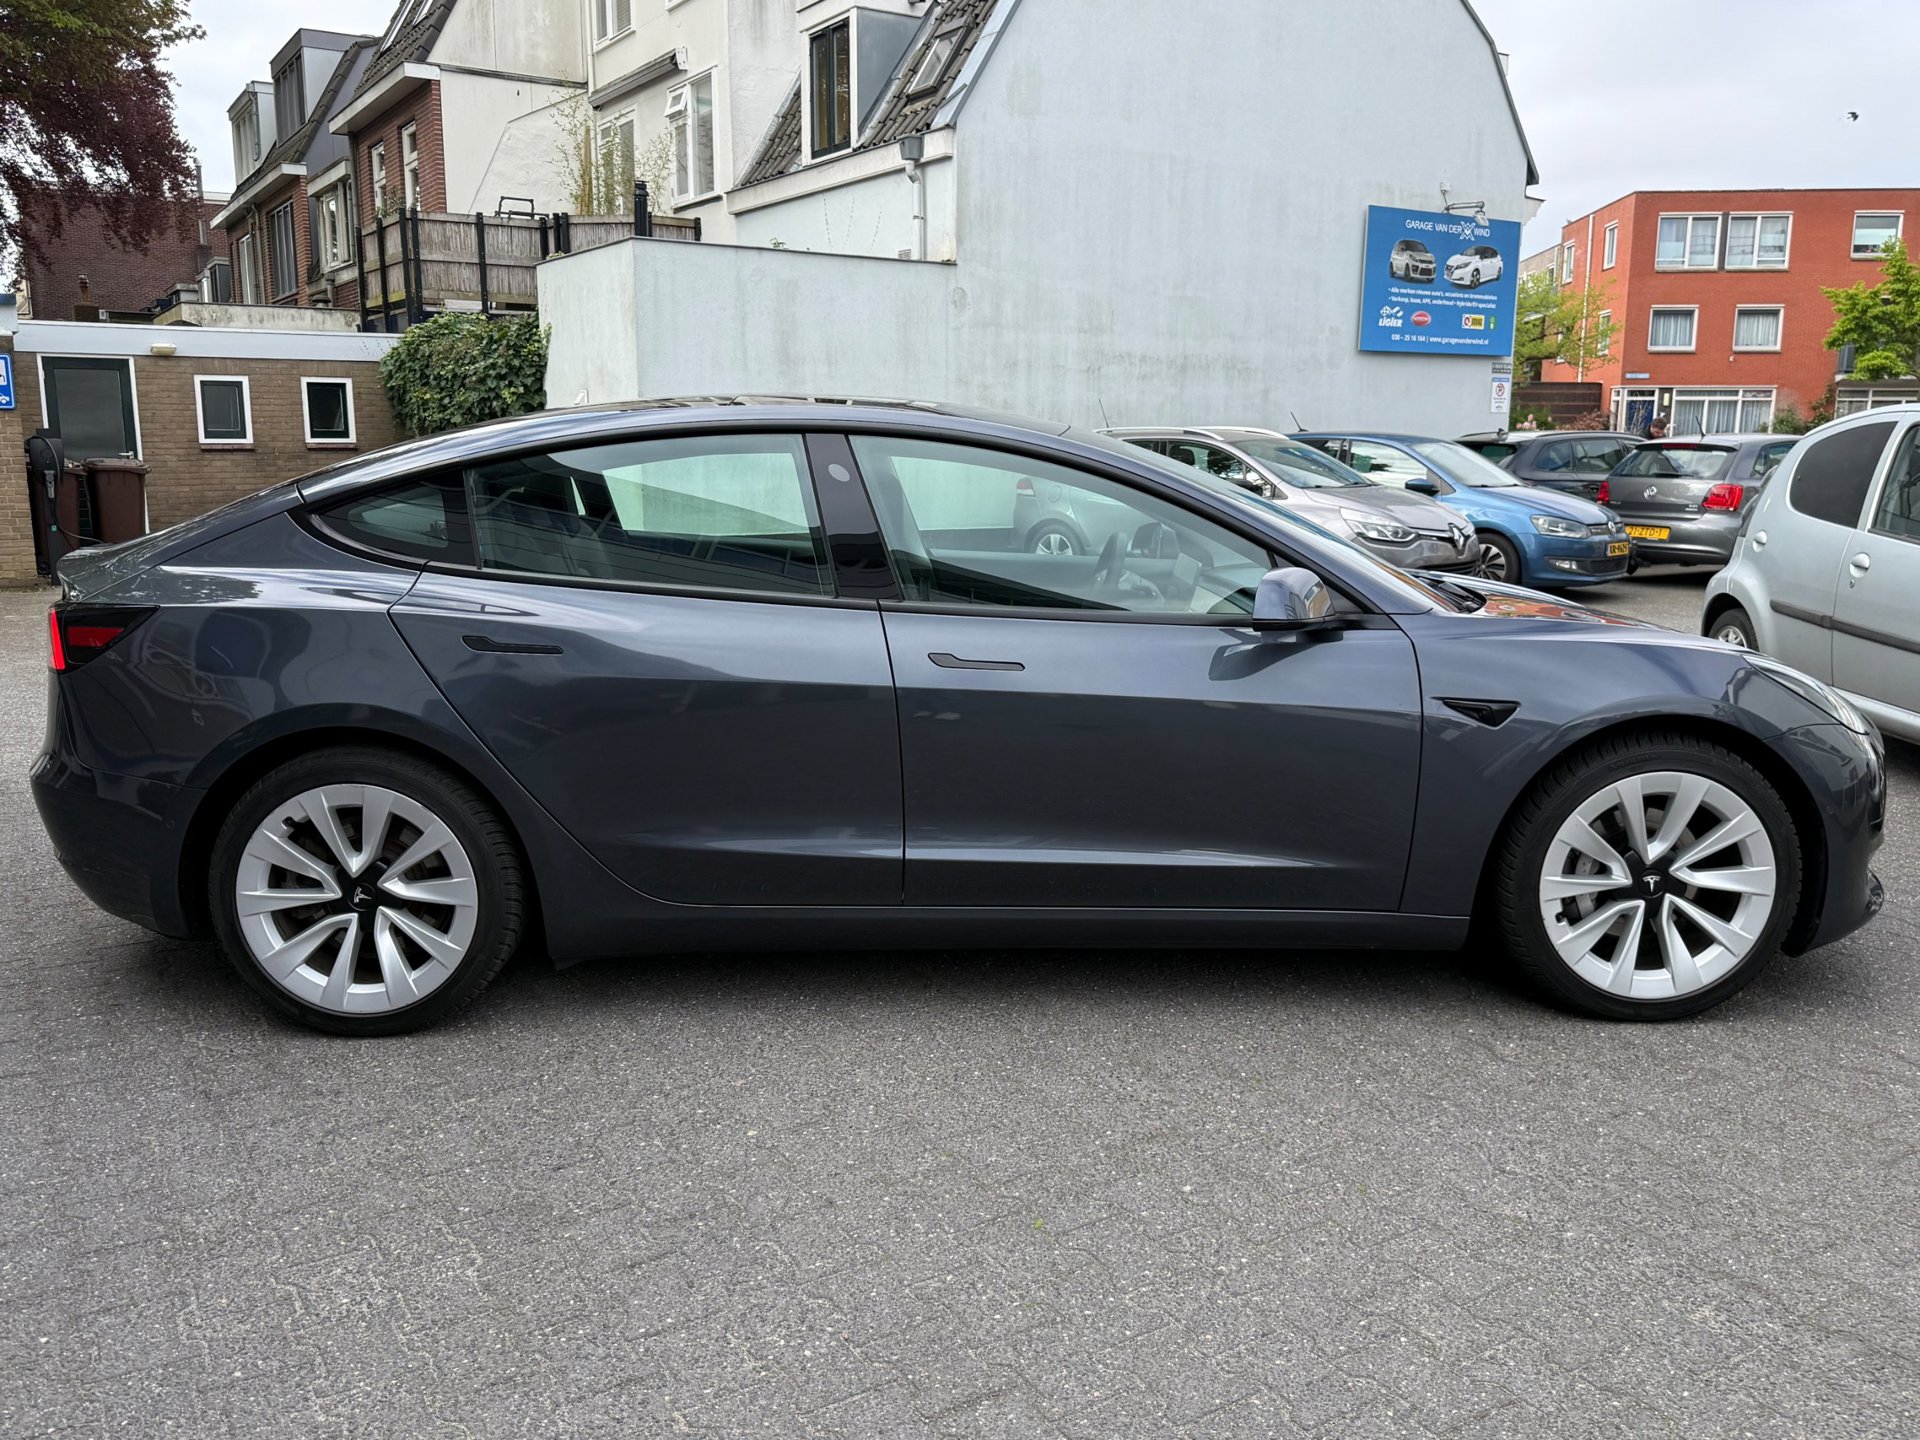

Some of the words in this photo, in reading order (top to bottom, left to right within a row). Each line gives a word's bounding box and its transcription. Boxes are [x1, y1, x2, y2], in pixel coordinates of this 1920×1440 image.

[1405, 219, 1433, 231] GARAGE
[1434, 223, 1448, 233] VAN
[1449, 224, 1462, 234] DER
[1473, 227, 1490, 237] WIND
[1378, 317, 1403, 327] LIGIER
